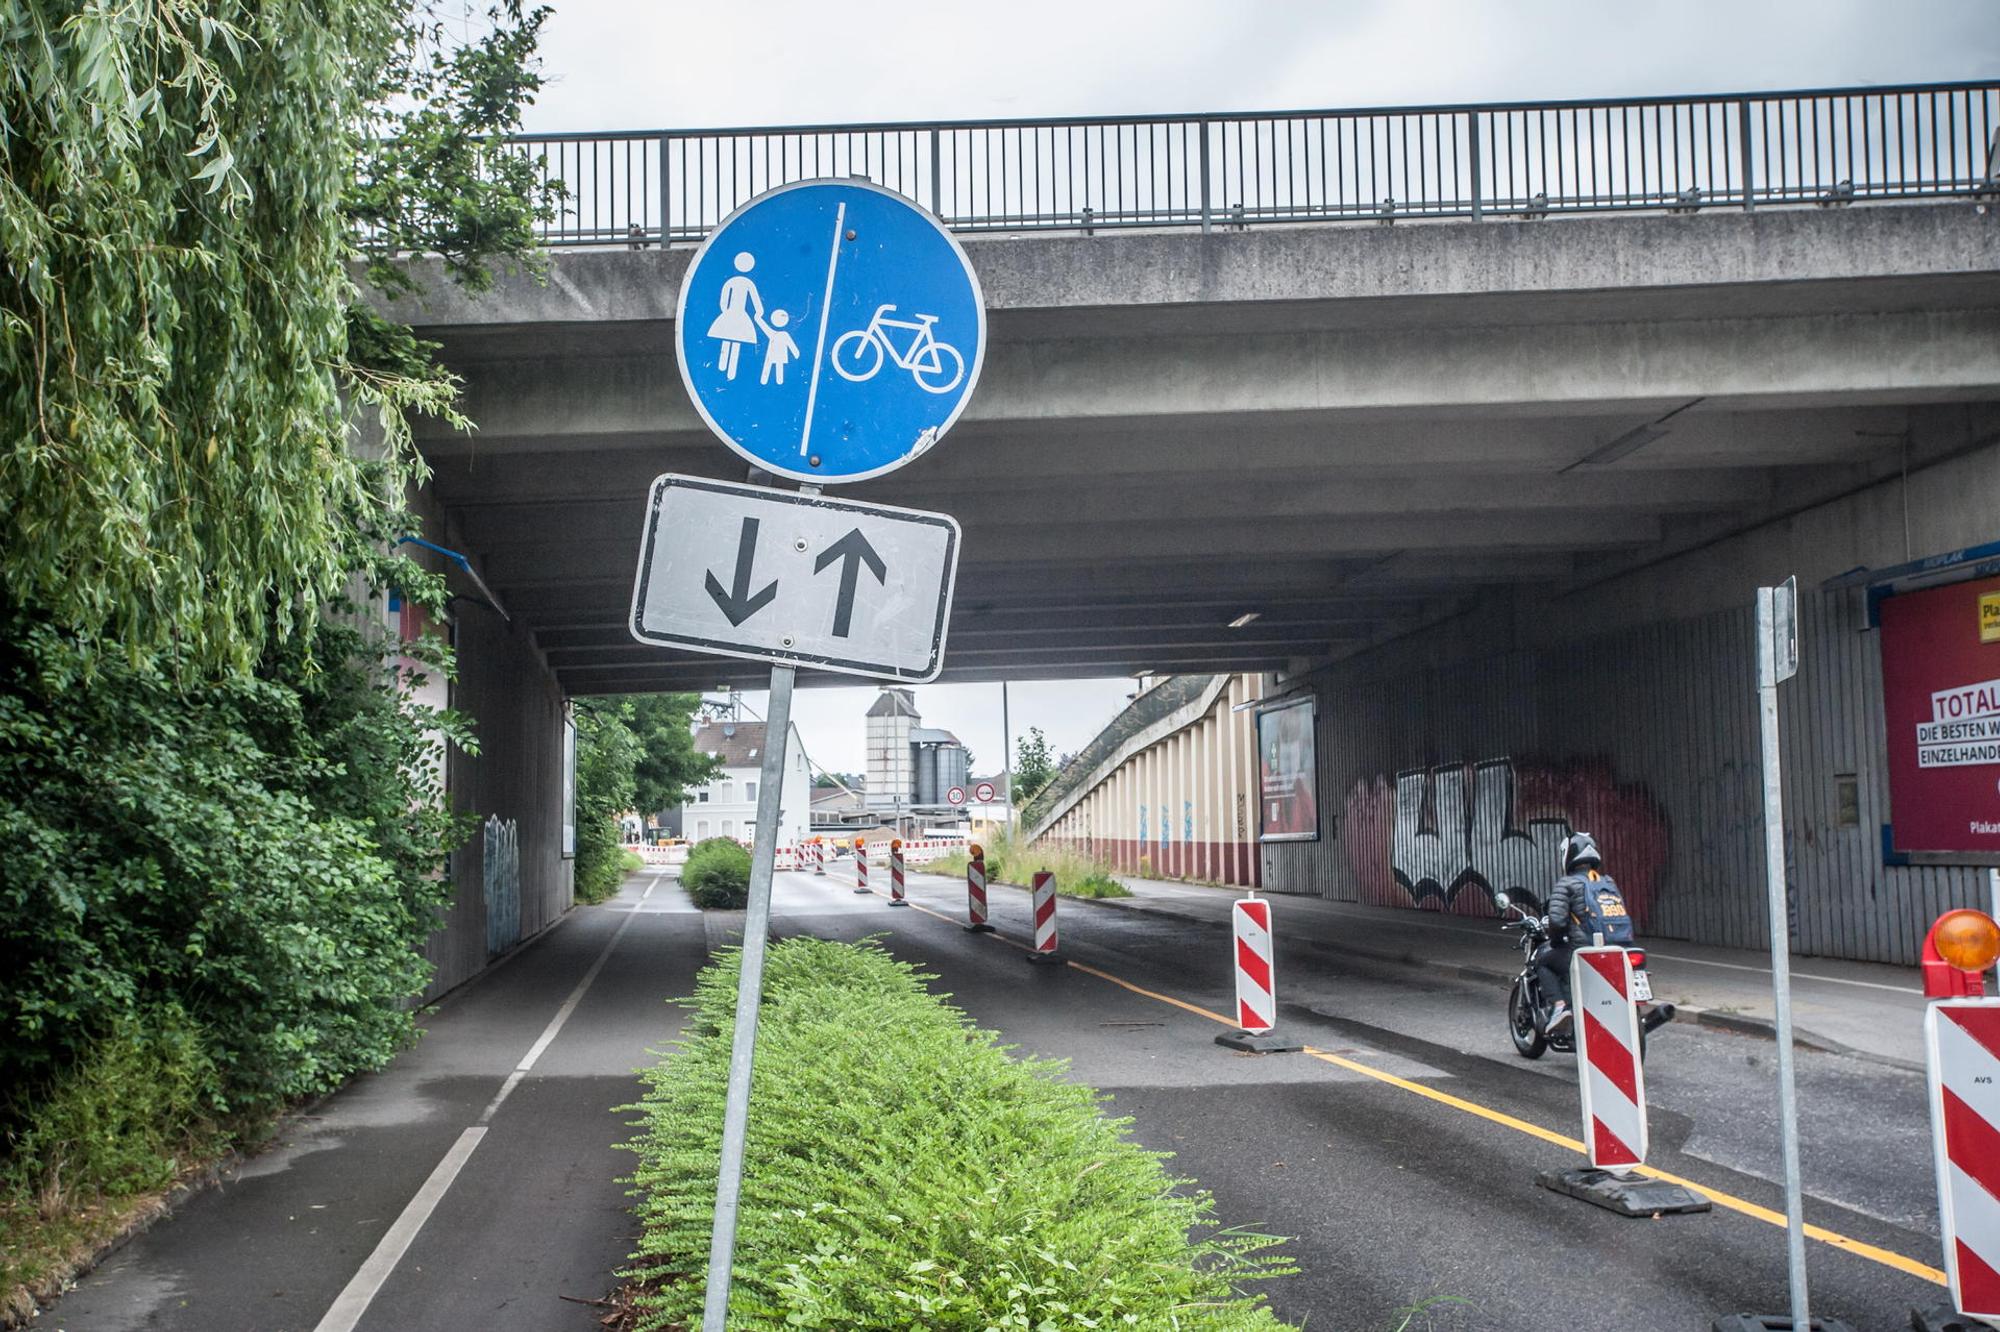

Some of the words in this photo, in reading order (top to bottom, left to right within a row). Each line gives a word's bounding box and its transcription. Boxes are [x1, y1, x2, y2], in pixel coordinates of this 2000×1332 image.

[1936, 688, 2000, 719] TOTAL
[1919, 726, 1938, 742] DIE
[1941, 721, 1985, 740] BESTEN
[1974, 1076, 1993, 1084] AVS
